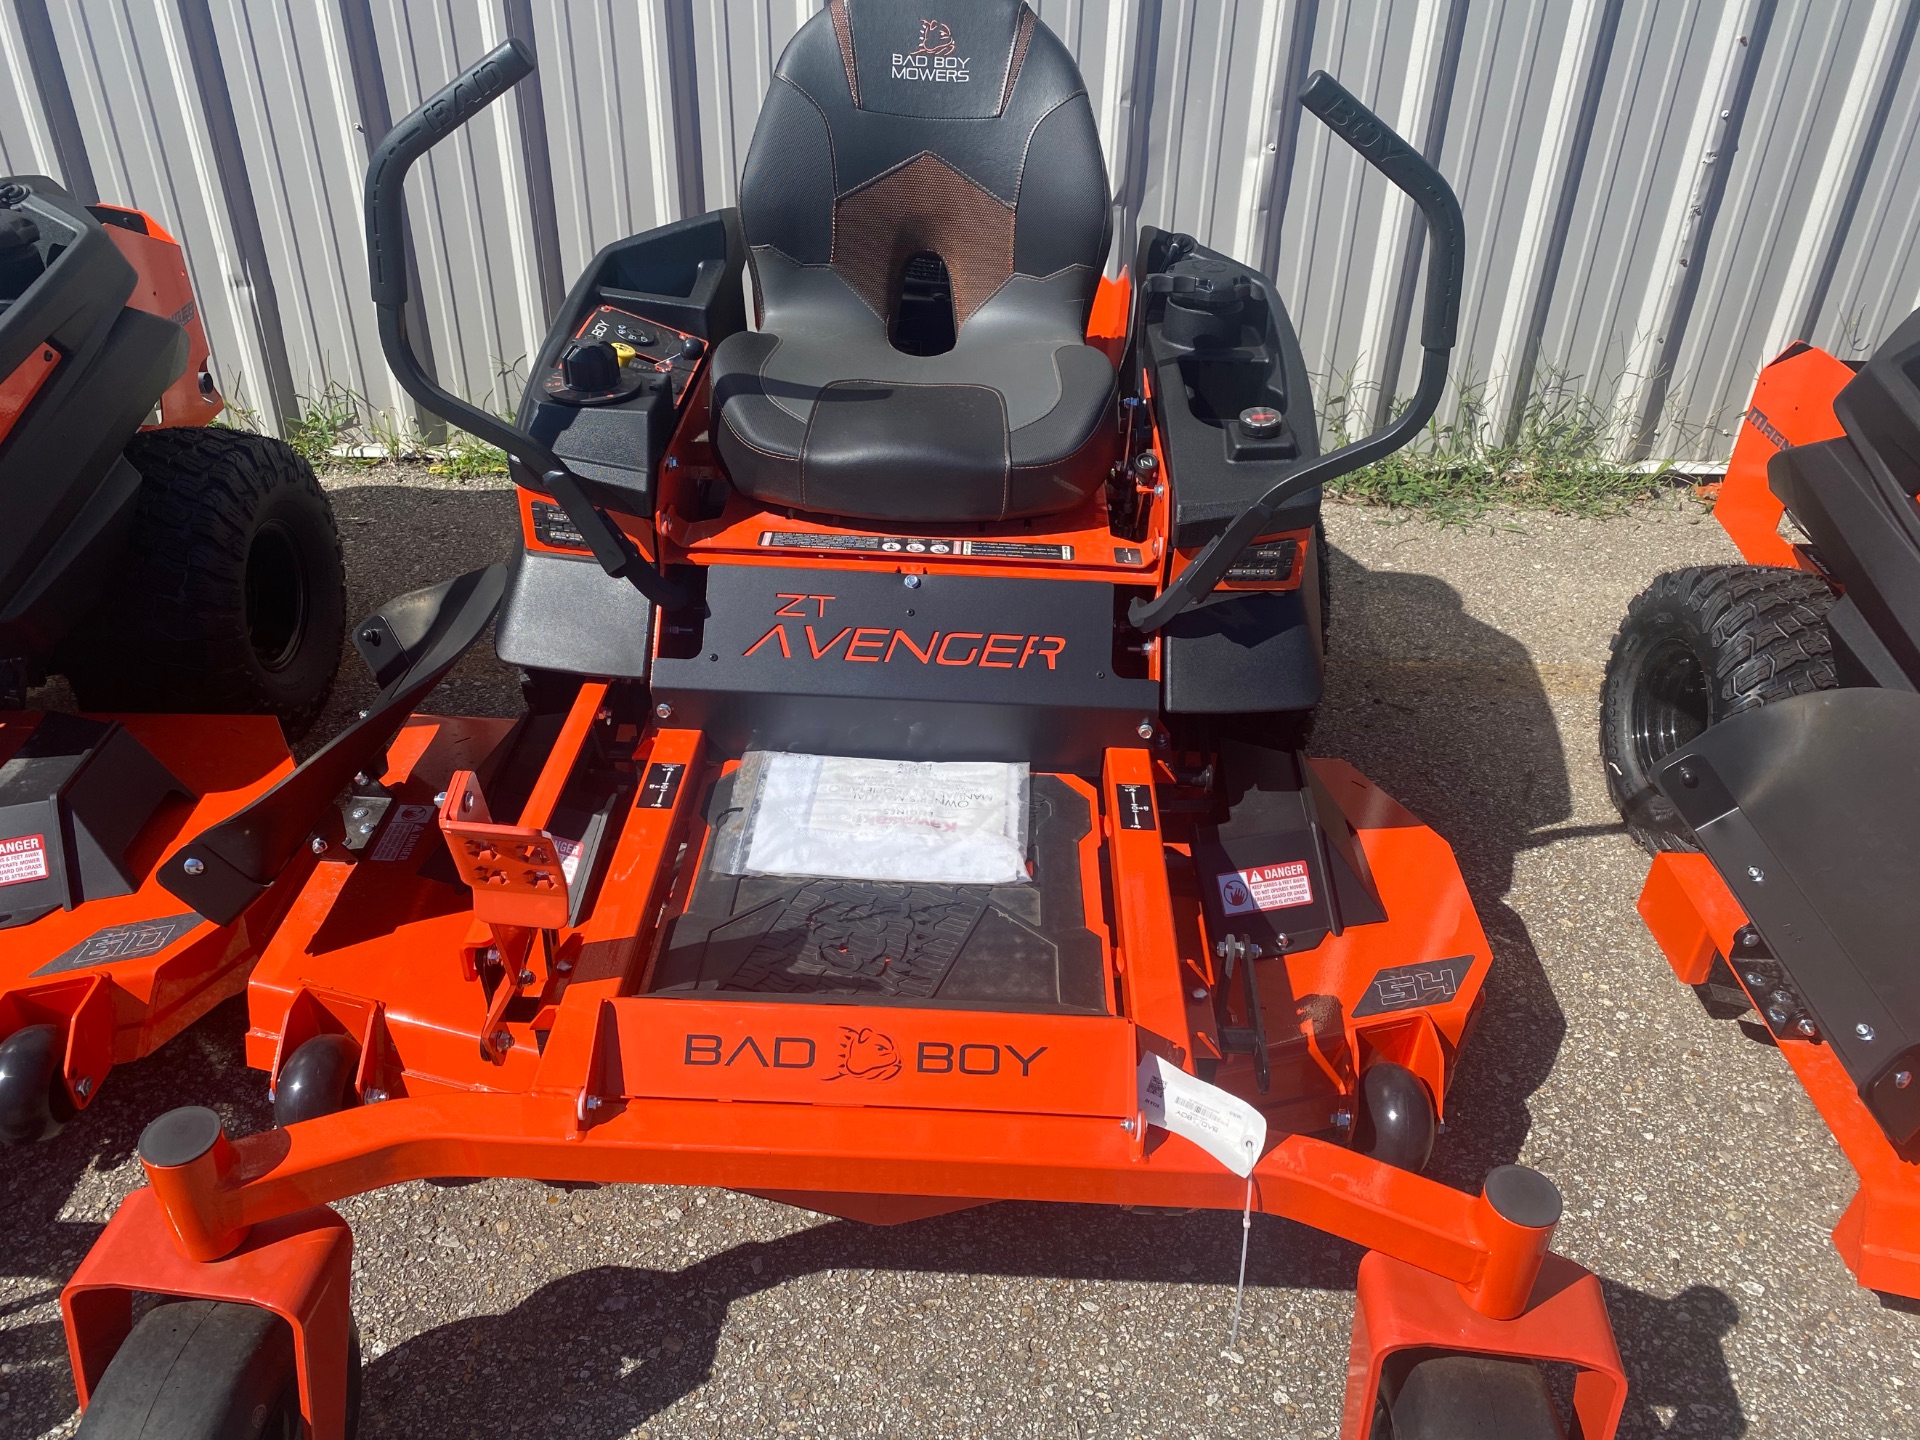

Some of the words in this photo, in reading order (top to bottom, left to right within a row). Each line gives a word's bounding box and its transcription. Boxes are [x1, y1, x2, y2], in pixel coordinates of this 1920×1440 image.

[891, 65, 970, 83] MOWERS
[892, 53, 928, 67] BAD
[934, 56, 971, 69] BOY
[423, 61, 503, 134] BAD
[1321, 93, 1409, 163] BOY
[591, 319, 610, 337] BOY
[1746, 405, 1795, 451] MAGN
[775, 592, 836, 618] ZT
[742, 623, 1066, 670] AVENGER
[0, 838, 40, 855] ANGER
[397, 834, 420, 861] DANGER
[0, 861, 19, 869] PERATE
[0, 868, 15, 876] UARD
[1264, 864, 1305, 880] DANGER
[1374, 968, 1456, 1006] 54
[684, 1034, 816, 1069] BAD
[917, 1041, 1048, 1077] BOY
